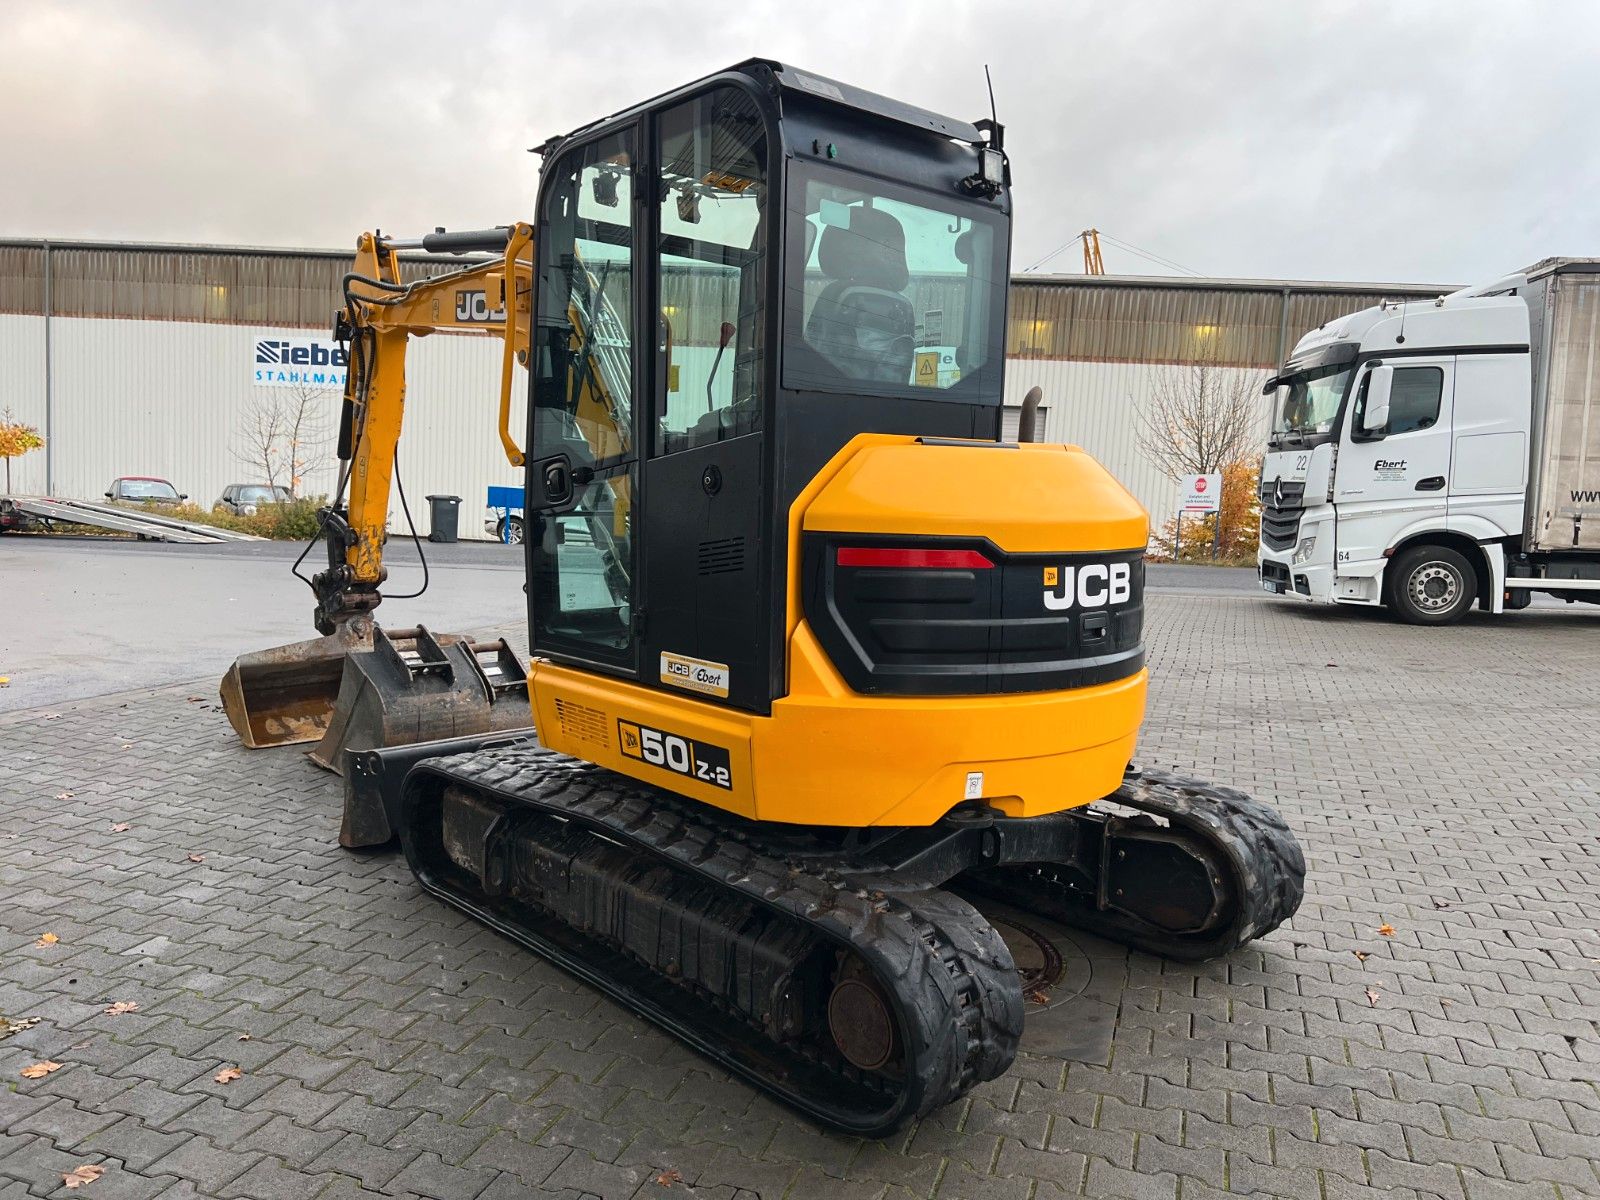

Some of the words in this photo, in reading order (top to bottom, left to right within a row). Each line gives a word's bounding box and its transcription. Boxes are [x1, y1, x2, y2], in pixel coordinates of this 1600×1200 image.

[1296, 455, 1307, 470] 22
[1374, 459, 1407, 470] Ebert
[1570, 490, 1600, 502] ww
[1338, 551, 1350, 561] 64
[1043, 562, 1130, 610] JCB
[668, 662, 689, 676] JCB
[697, 668, 721, 685] Ebert
[641, 728, 689, 773] 50
